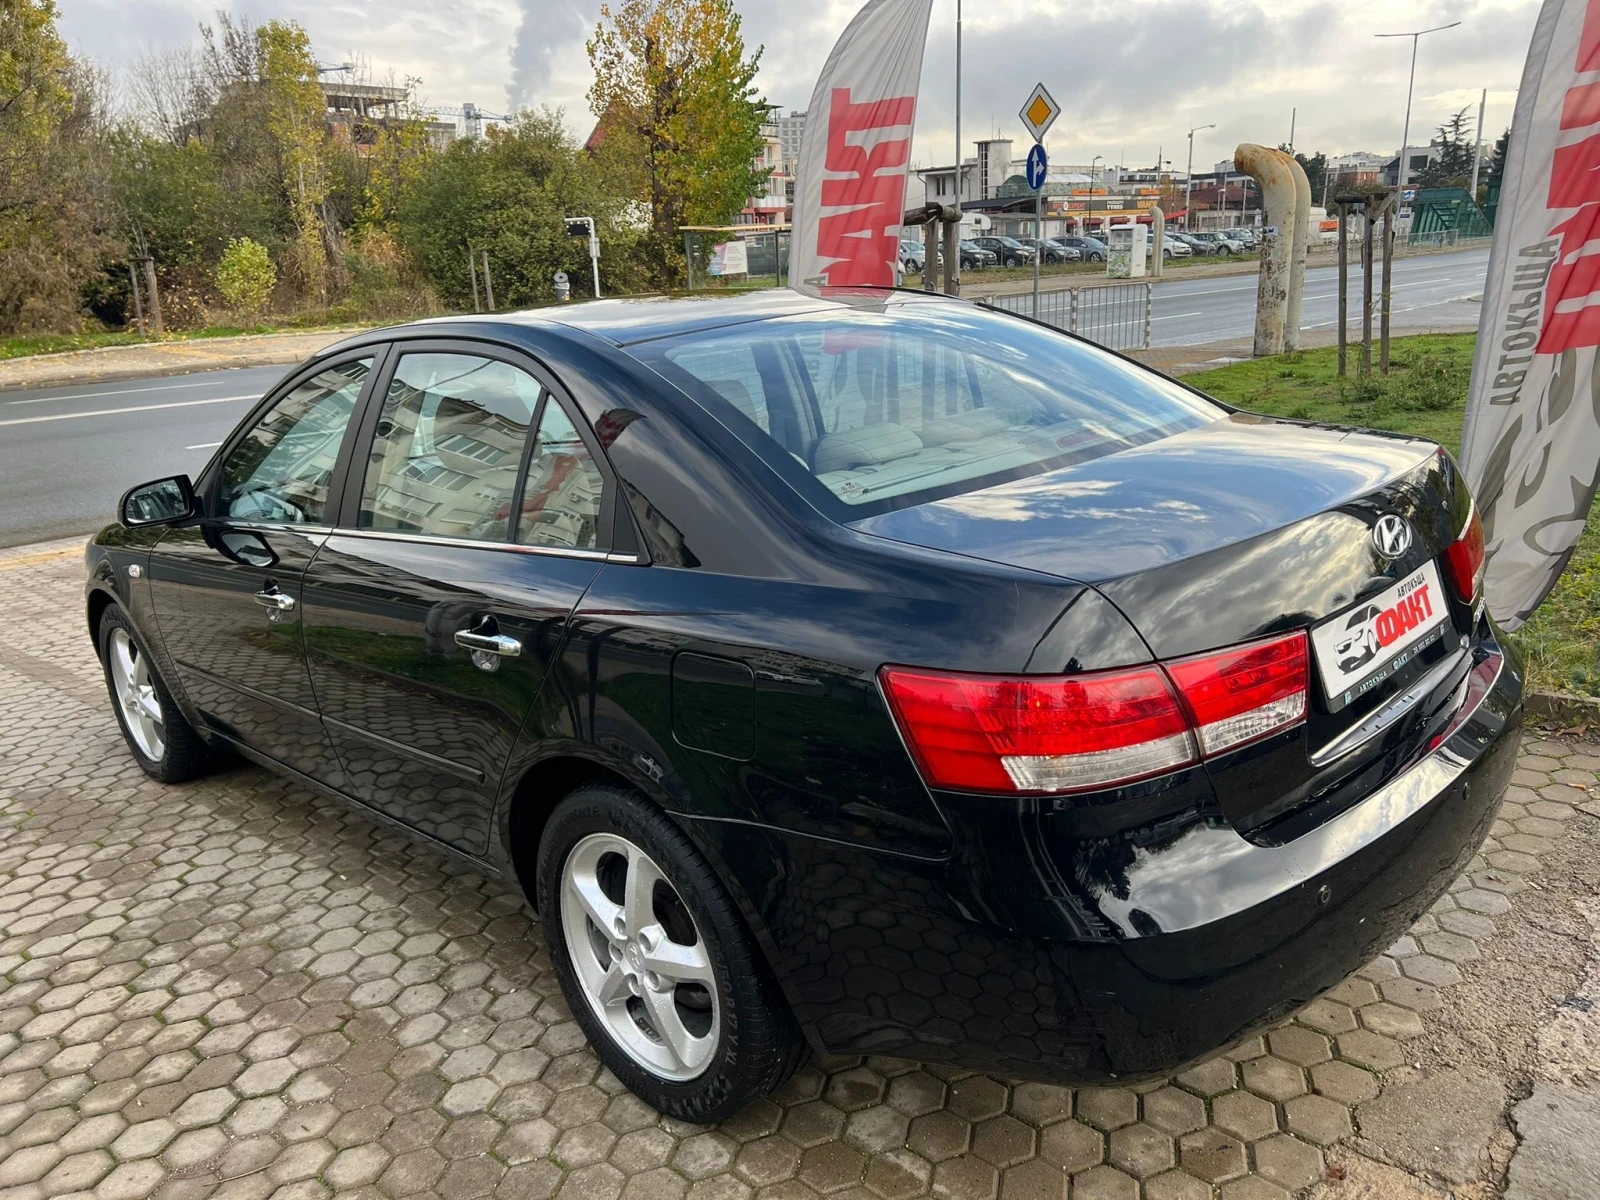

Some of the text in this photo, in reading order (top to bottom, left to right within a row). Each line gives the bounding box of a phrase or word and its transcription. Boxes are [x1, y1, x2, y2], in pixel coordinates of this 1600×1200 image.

[1490, 236, 1560, 406] АВТОКЪЩА
[1375, 583, 1434, 648] ФАКТ
[1397, 571, 1426, 599] АВТОКЪЩА
